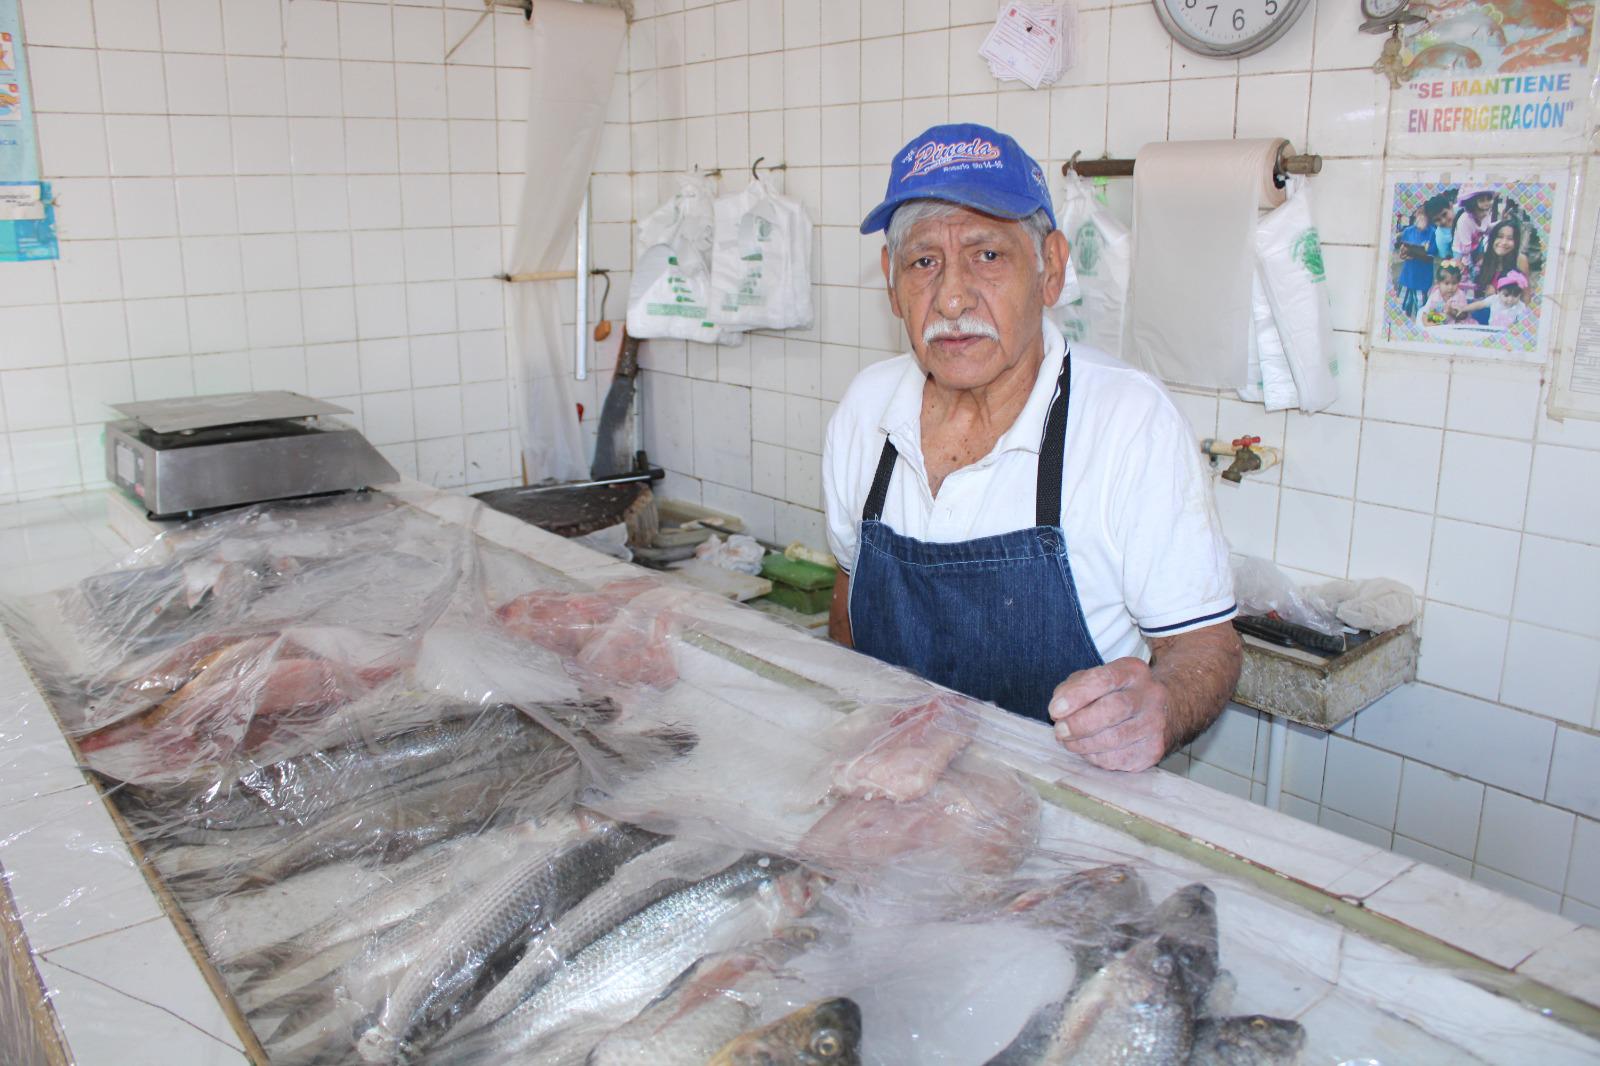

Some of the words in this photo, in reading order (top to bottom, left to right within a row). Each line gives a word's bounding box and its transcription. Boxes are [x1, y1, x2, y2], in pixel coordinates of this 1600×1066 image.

[1206, 5, 1218, 27] 7
[1232, 8, 1245, 31] 6
[1265, 0, 1278, 15] 5
[1409, 81, 1444, 99] "SE
[1451, 73, 1571, 97] MANTIENE
[1408, 109, 1428, 133] EN
[1433, 96, 1574, 132] REFRIGERACIÓN"
[911, 138, 994, 173] Pineda
